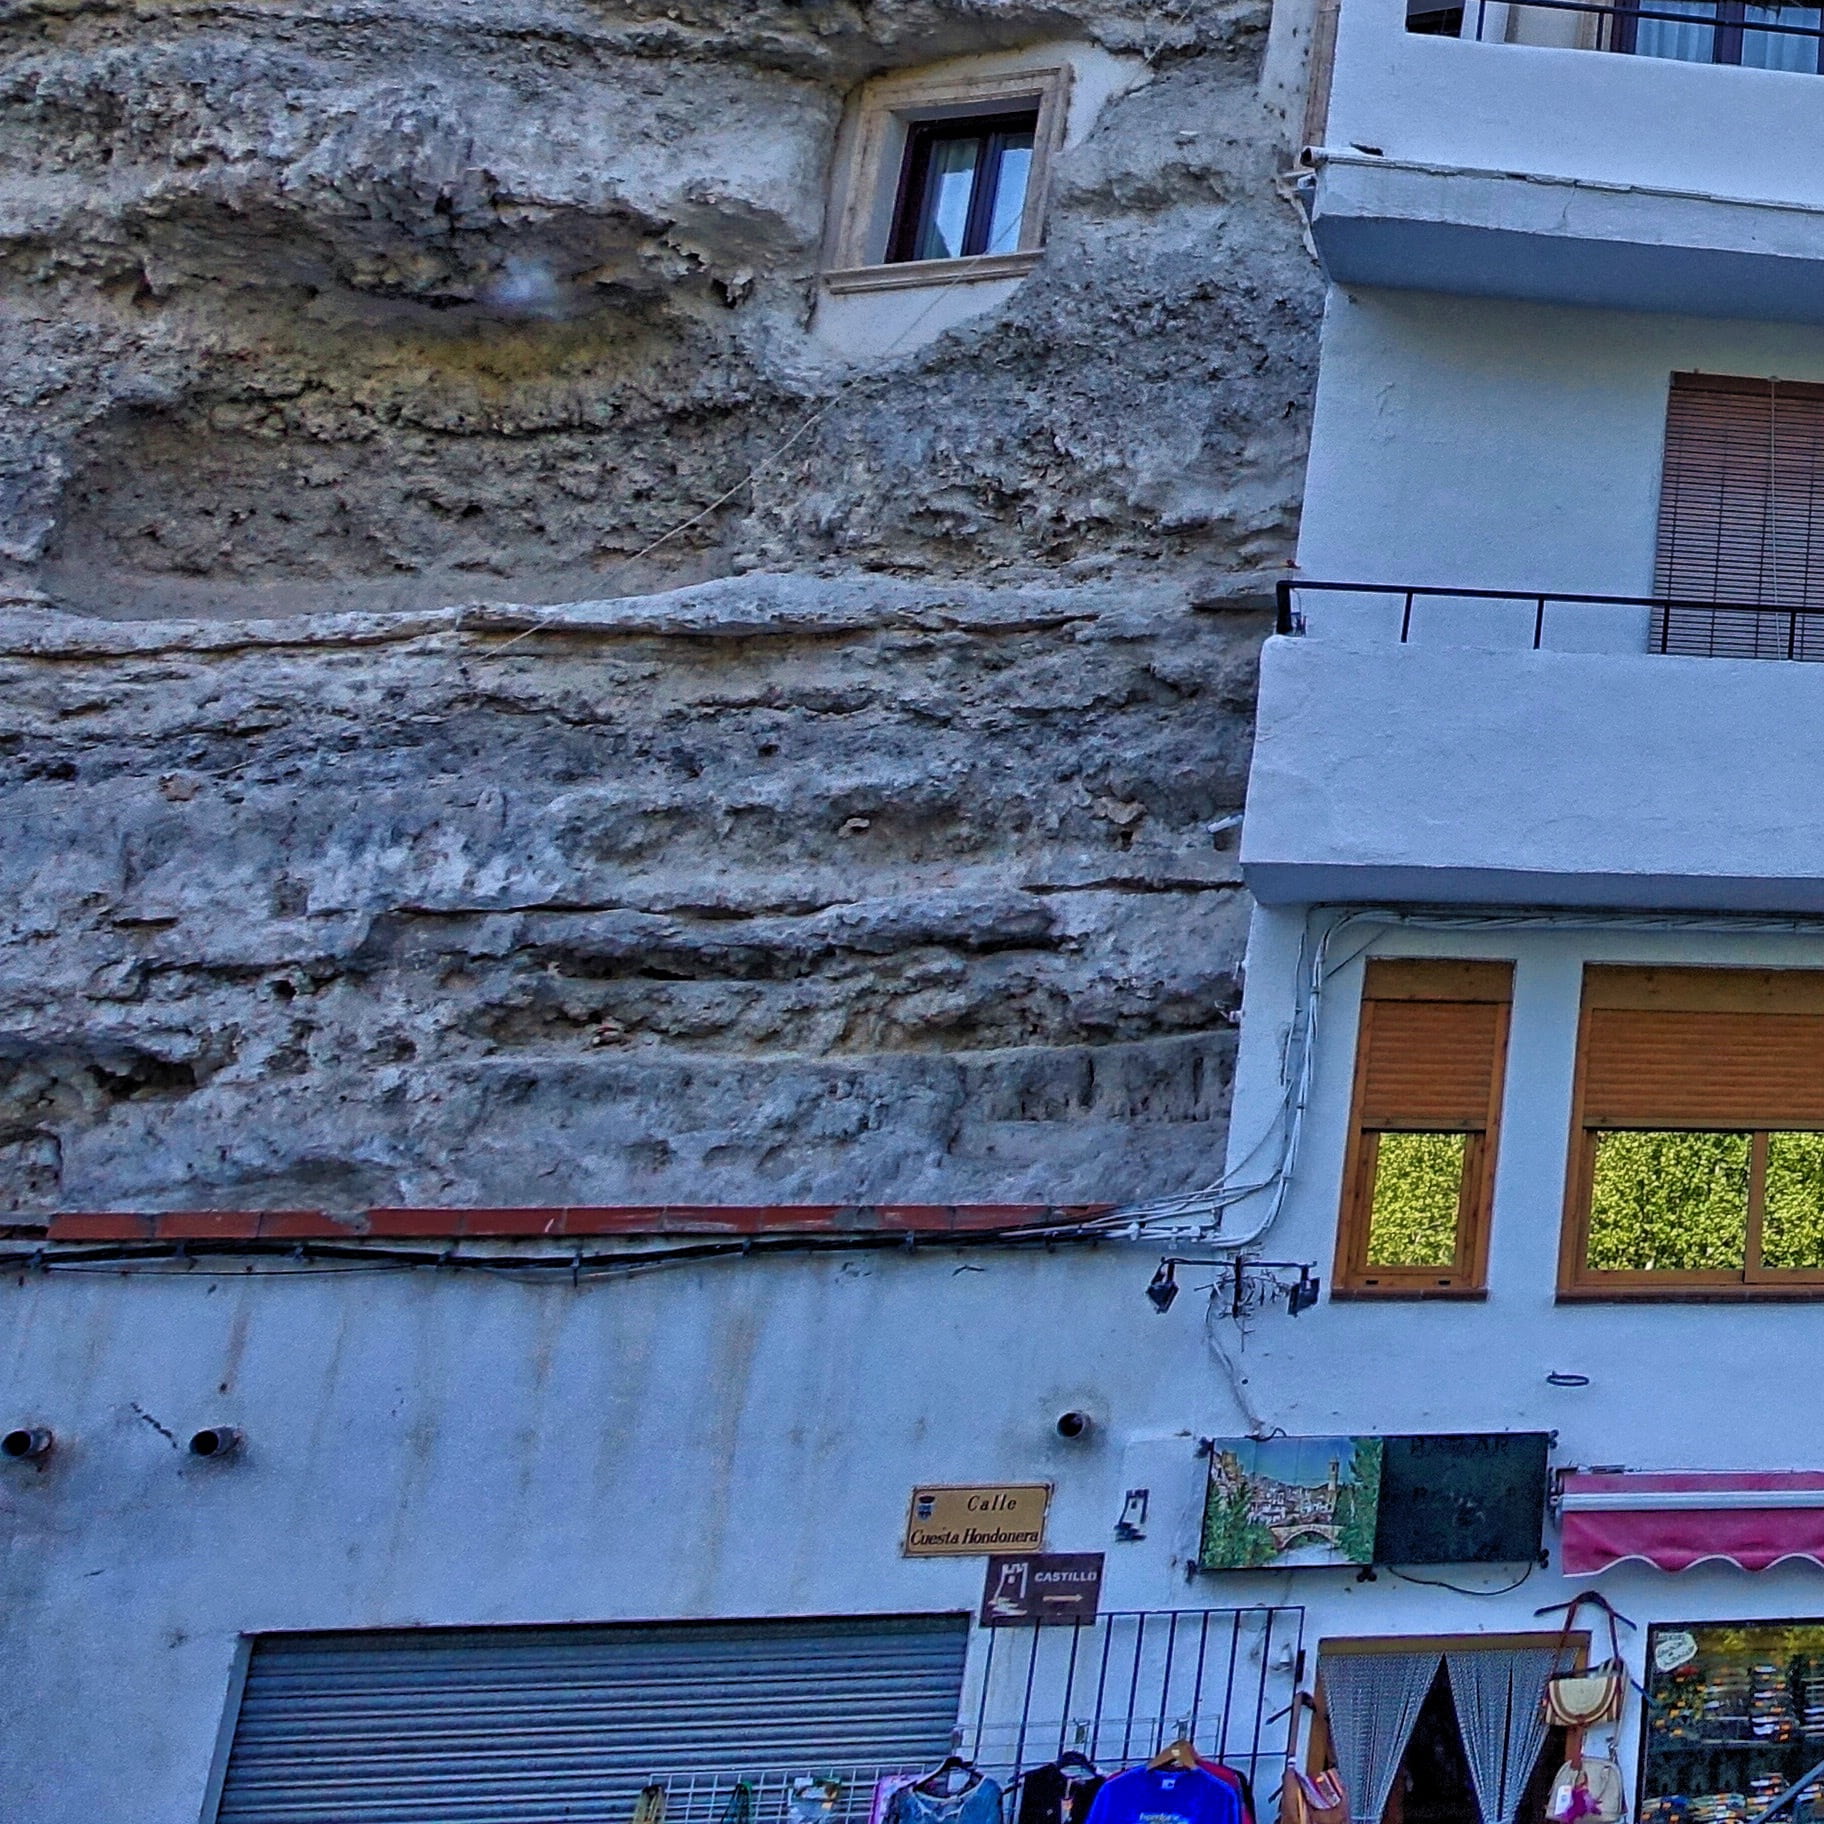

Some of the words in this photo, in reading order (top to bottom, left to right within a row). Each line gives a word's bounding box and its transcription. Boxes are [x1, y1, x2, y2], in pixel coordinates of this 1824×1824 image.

[967, 1494, 1017, 1512] Calle
[910, 1529, 959, 1546] Cuesta
[962, 1527, 1039, 1544] Hondonera
[1034, 1571, 1098, 1582] CASTILLO
